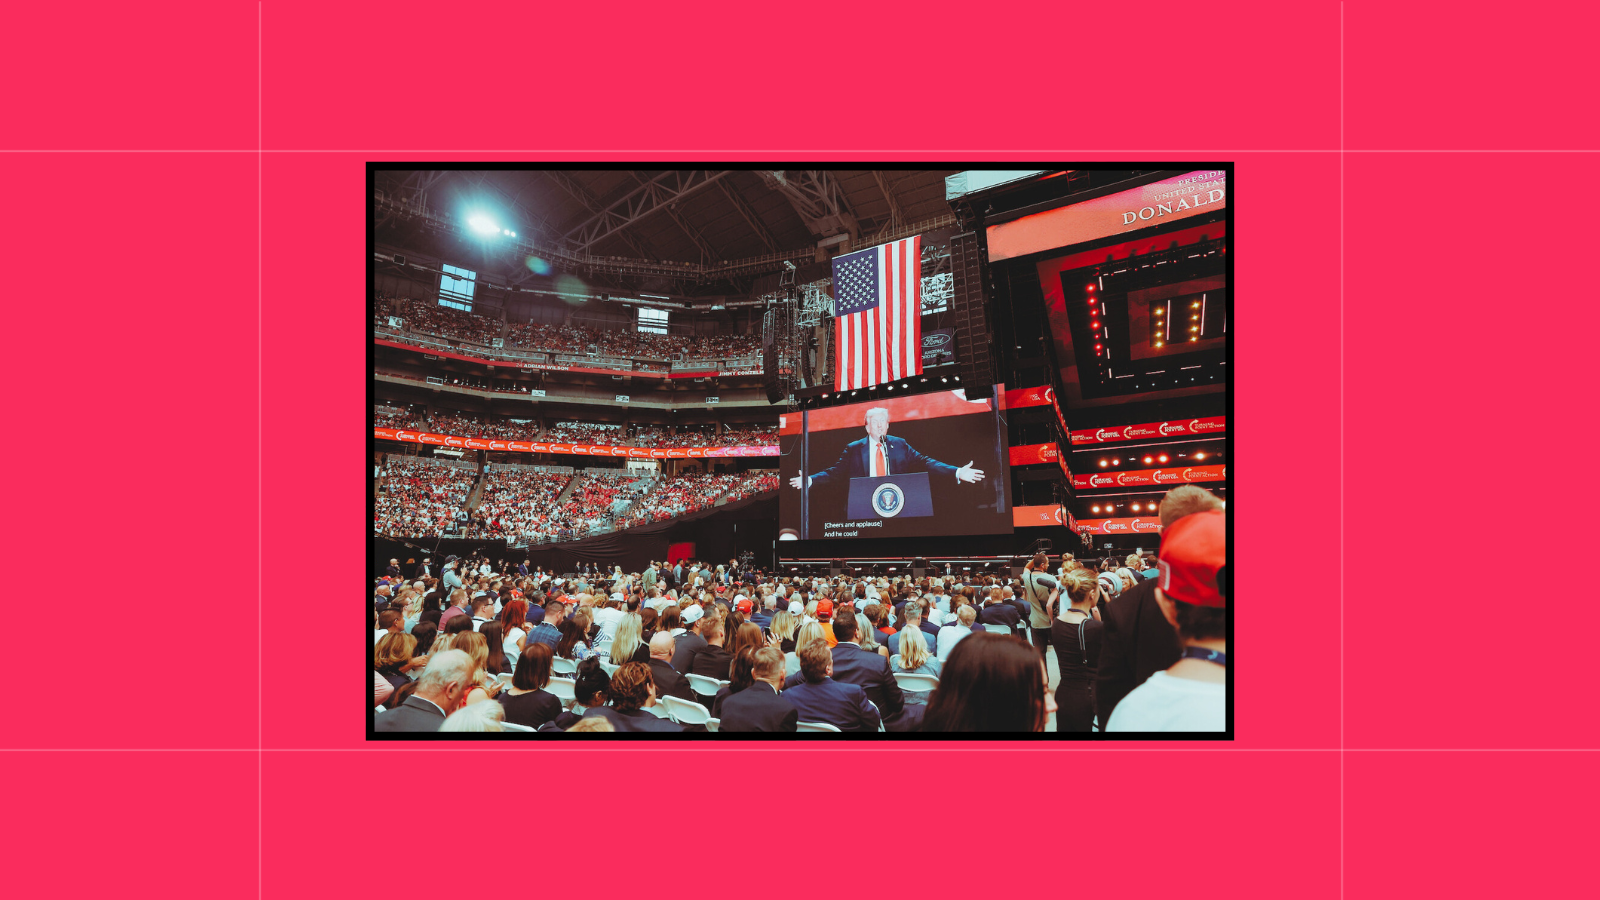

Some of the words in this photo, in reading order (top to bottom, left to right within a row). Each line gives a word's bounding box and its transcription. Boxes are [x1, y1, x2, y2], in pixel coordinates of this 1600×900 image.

[1154, 186, 1195, 201] UNITED
[1121, 188, 1225, 225] DONALD
[923, 336, 944, 346] Ford
[824, 522, 844, 530] [Cheers
[855, 520, 883, 528] applause]
